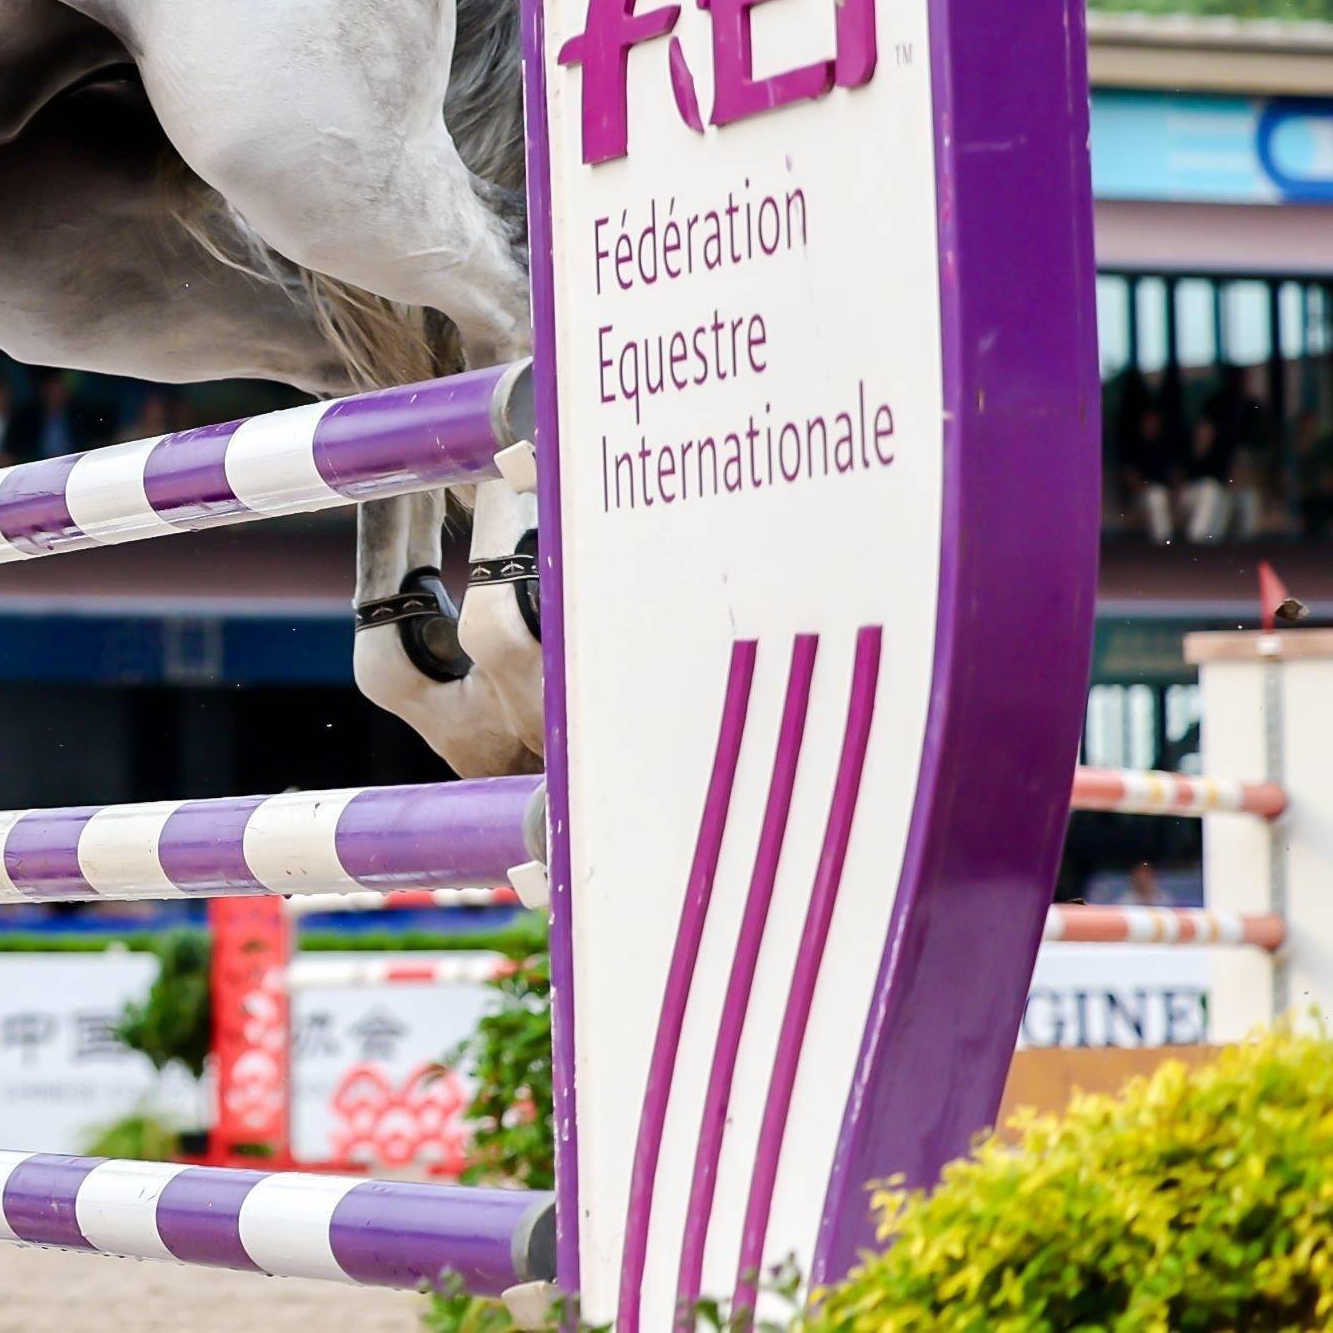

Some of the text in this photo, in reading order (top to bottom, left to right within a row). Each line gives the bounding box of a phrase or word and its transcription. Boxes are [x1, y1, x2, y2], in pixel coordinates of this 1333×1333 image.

[594, 177, 808, 295] Fédération
[598, 309, 767, 425] Equestre
[601, 379, 895, 513] Internationale
